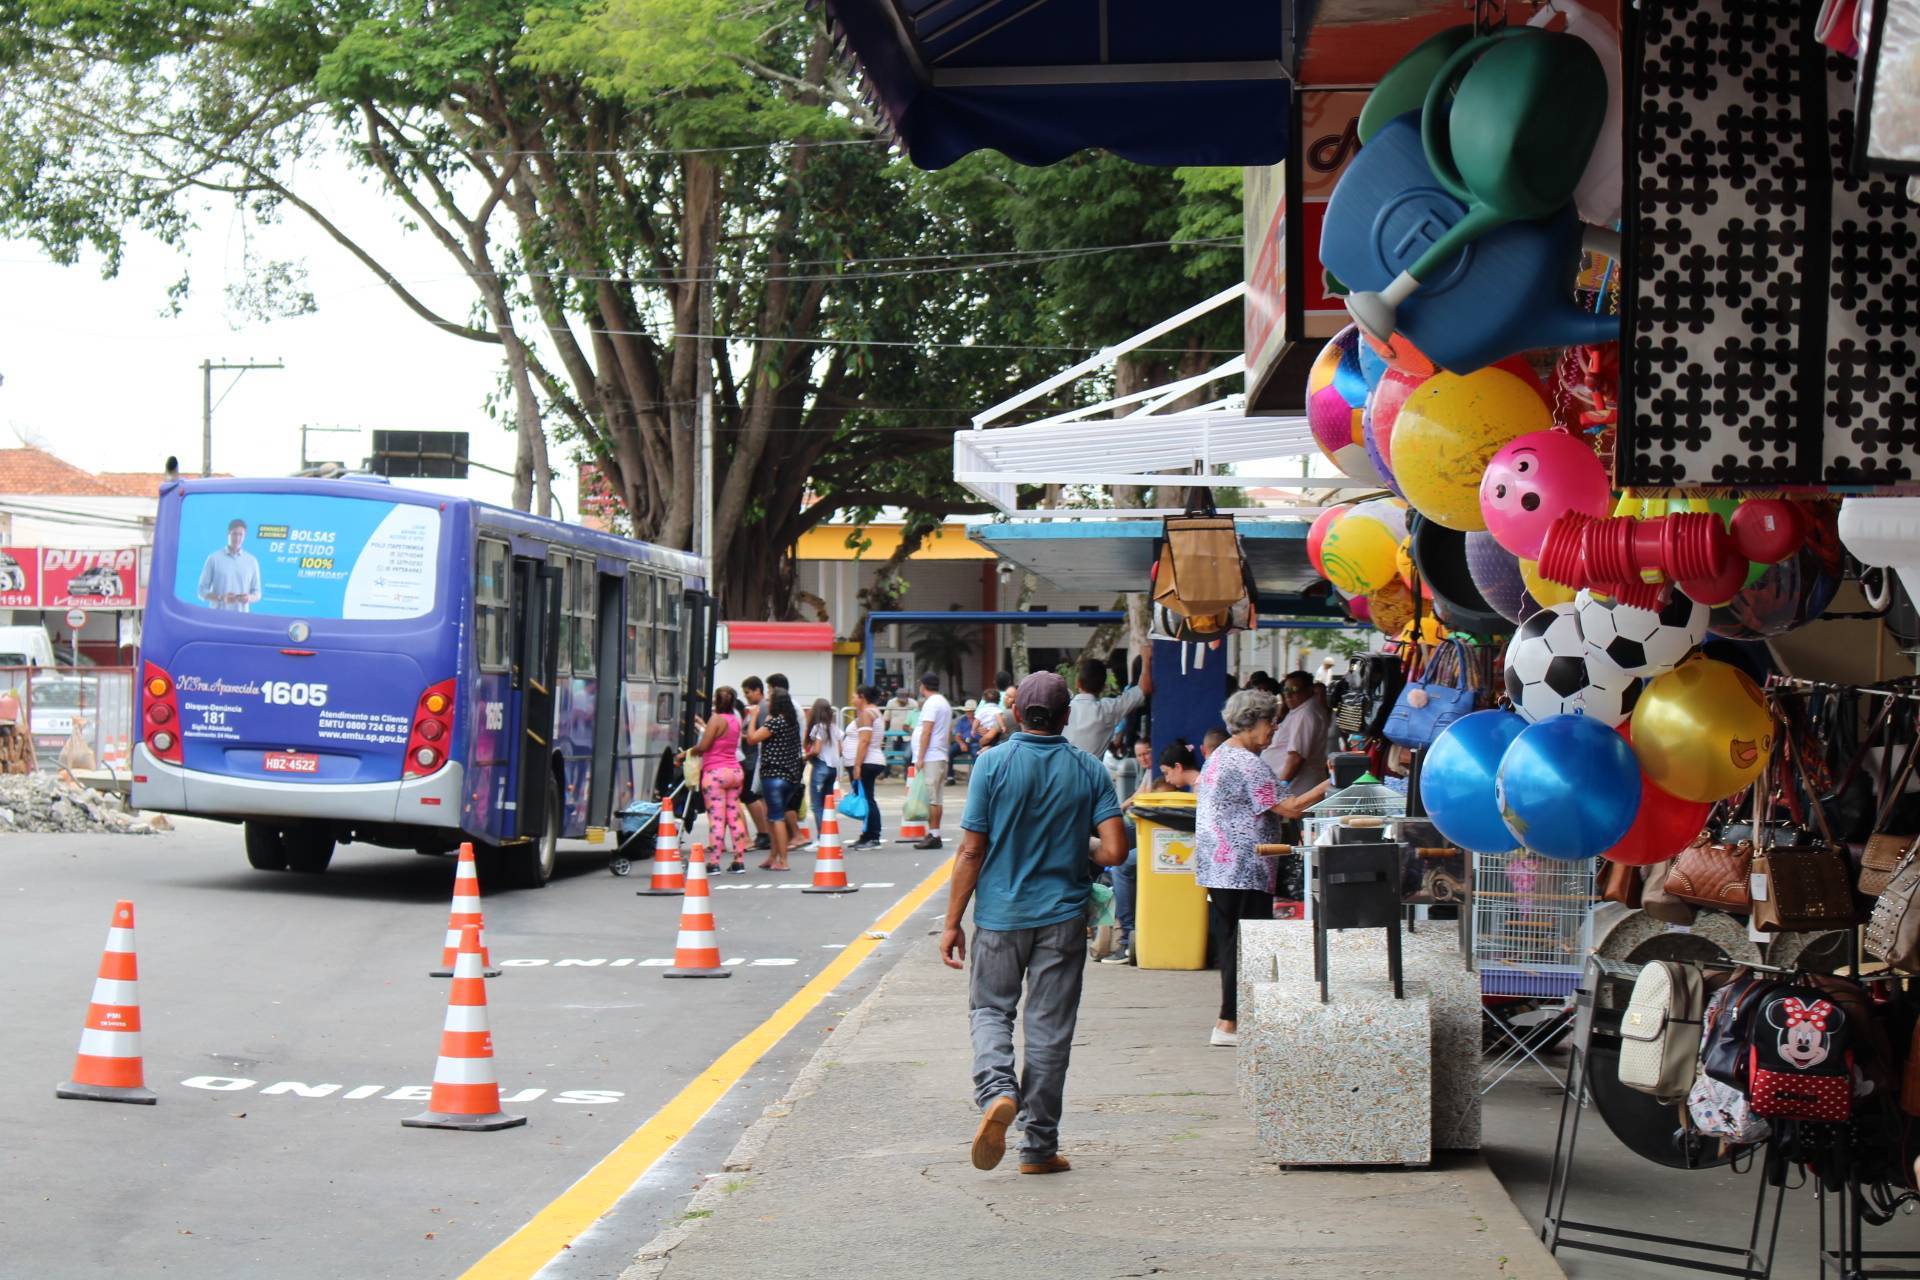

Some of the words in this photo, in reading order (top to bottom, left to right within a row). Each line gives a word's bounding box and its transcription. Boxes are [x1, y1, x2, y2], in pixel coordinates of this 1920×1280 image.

[290, 530, 336, 543] BOLSAS
[270, 542, 285, 552] DE
[288, 543, 334, 556] ESTUDO
[44, 550, 135, 571] DUTRA
[302, 557, 333, 569] 100%
[260, 681, 328, 706] 1605
[185, 702, 242, 713] Disque-Denúncia
[202, 711, 225, 724] 181
[320, 711, 368, 720] Atendimento
[381, 715, 408, 723] Cliente
[319, 719, 344, 728] EMTU
[346, 721, 366, 730] 0800
[368, 722, 383, 731] 724
[385, 724, 396, 732] 05
[318, 730, 407, 743] www.emtu.sp.gov.br
